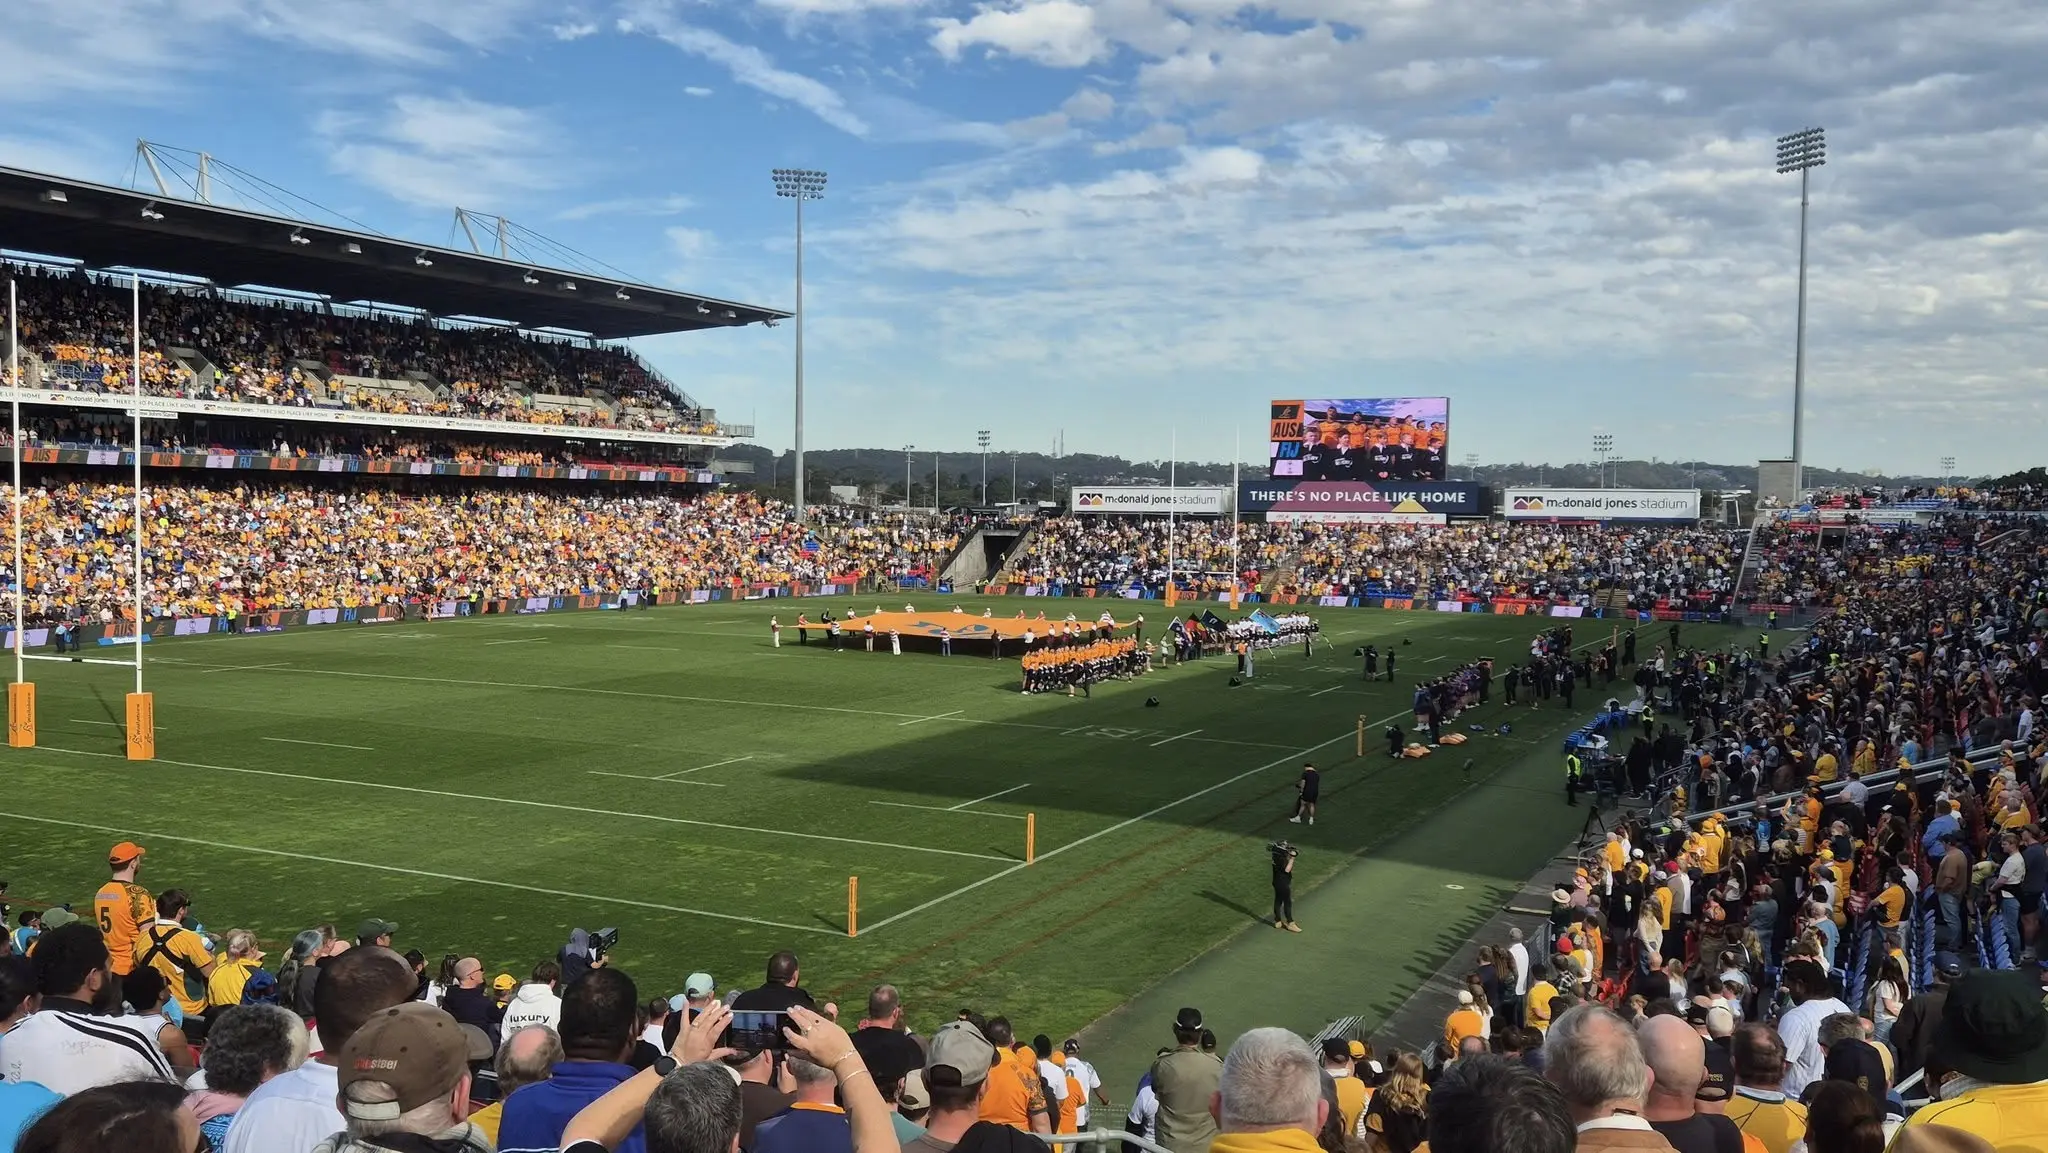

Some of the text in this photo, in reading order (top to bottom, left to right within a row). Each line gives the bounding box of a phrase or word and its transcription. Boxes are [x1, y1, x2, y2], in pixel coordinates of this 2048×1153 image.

[1272, 422, 1298, 438] AUS
[32, 449, 51, 462] AUS
[1279, 442, 1300, 458] FIJ
[240, 456, 252, 469] FIJ
[1104, 493, 1217, 506] mcdonald jones stadium
[1249, 490, 1466, 503] THERE'S NO PLACE LIKE HOME
[1546, 497, 1688, 511] mcdonald jones stadium
[100, 906, 112, 934] 5
[509, 1014, 550, 1024] luxury
